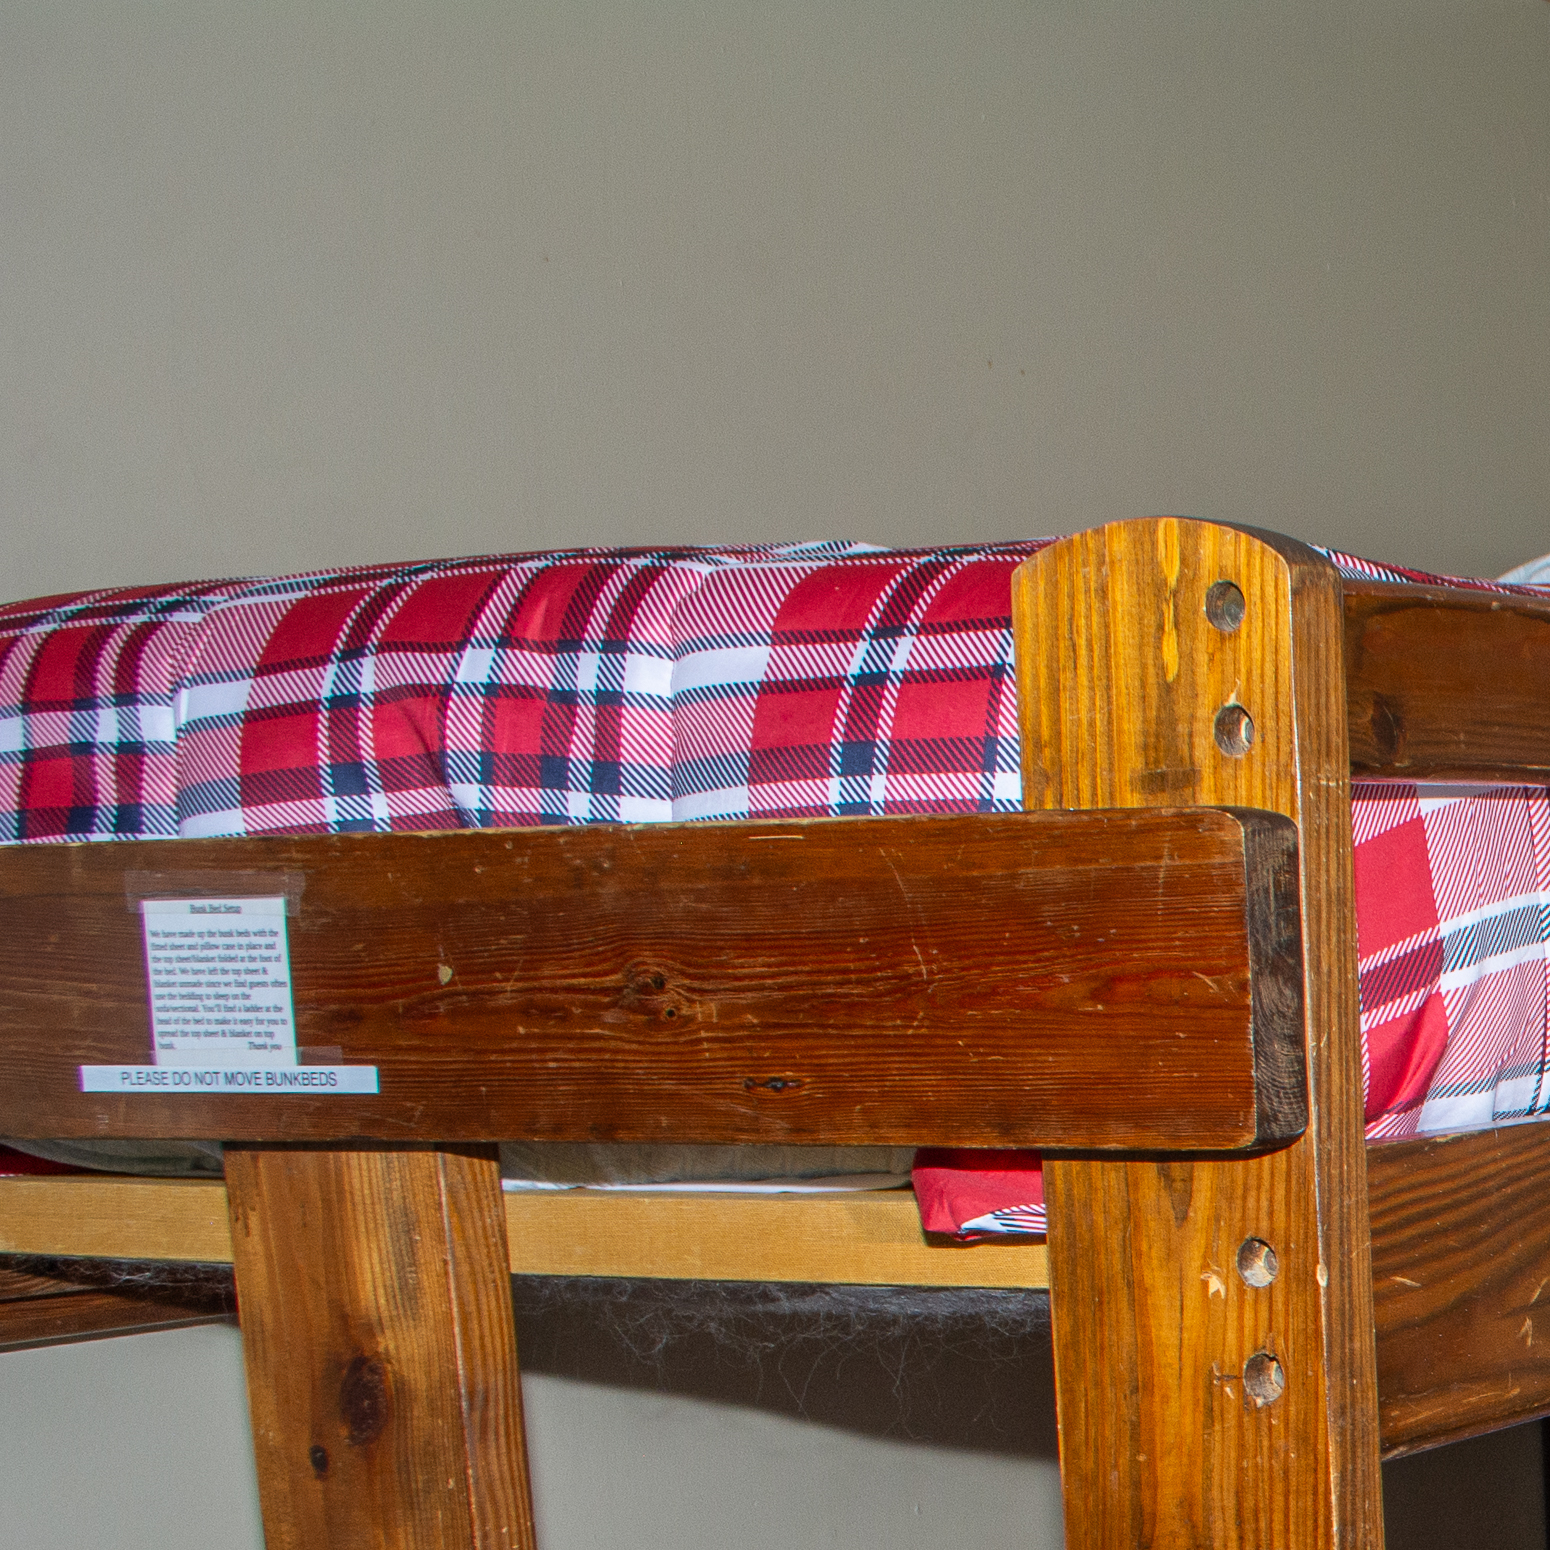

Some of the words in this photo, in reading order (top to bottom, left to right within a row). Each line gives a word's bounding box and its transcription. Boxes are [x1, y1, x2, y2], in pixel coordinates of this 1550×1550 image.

[190, 904, 208, 913] Bunk
[209, 904, 222, 913] Bed
[224, 904, 242, 913] Setup
[249, 1042, 268, 1050] Thank
[270, 1043, 283, 1052] you
[122, 1072, 169, 1085] PLEASE
[173, 1072, 191, 1085] DO
[195, 1072, 220, 1086] NOT
[225, 1072, 262, 1086] MOVE
[266, 1072, 337, 1086] BUNKBEDS
